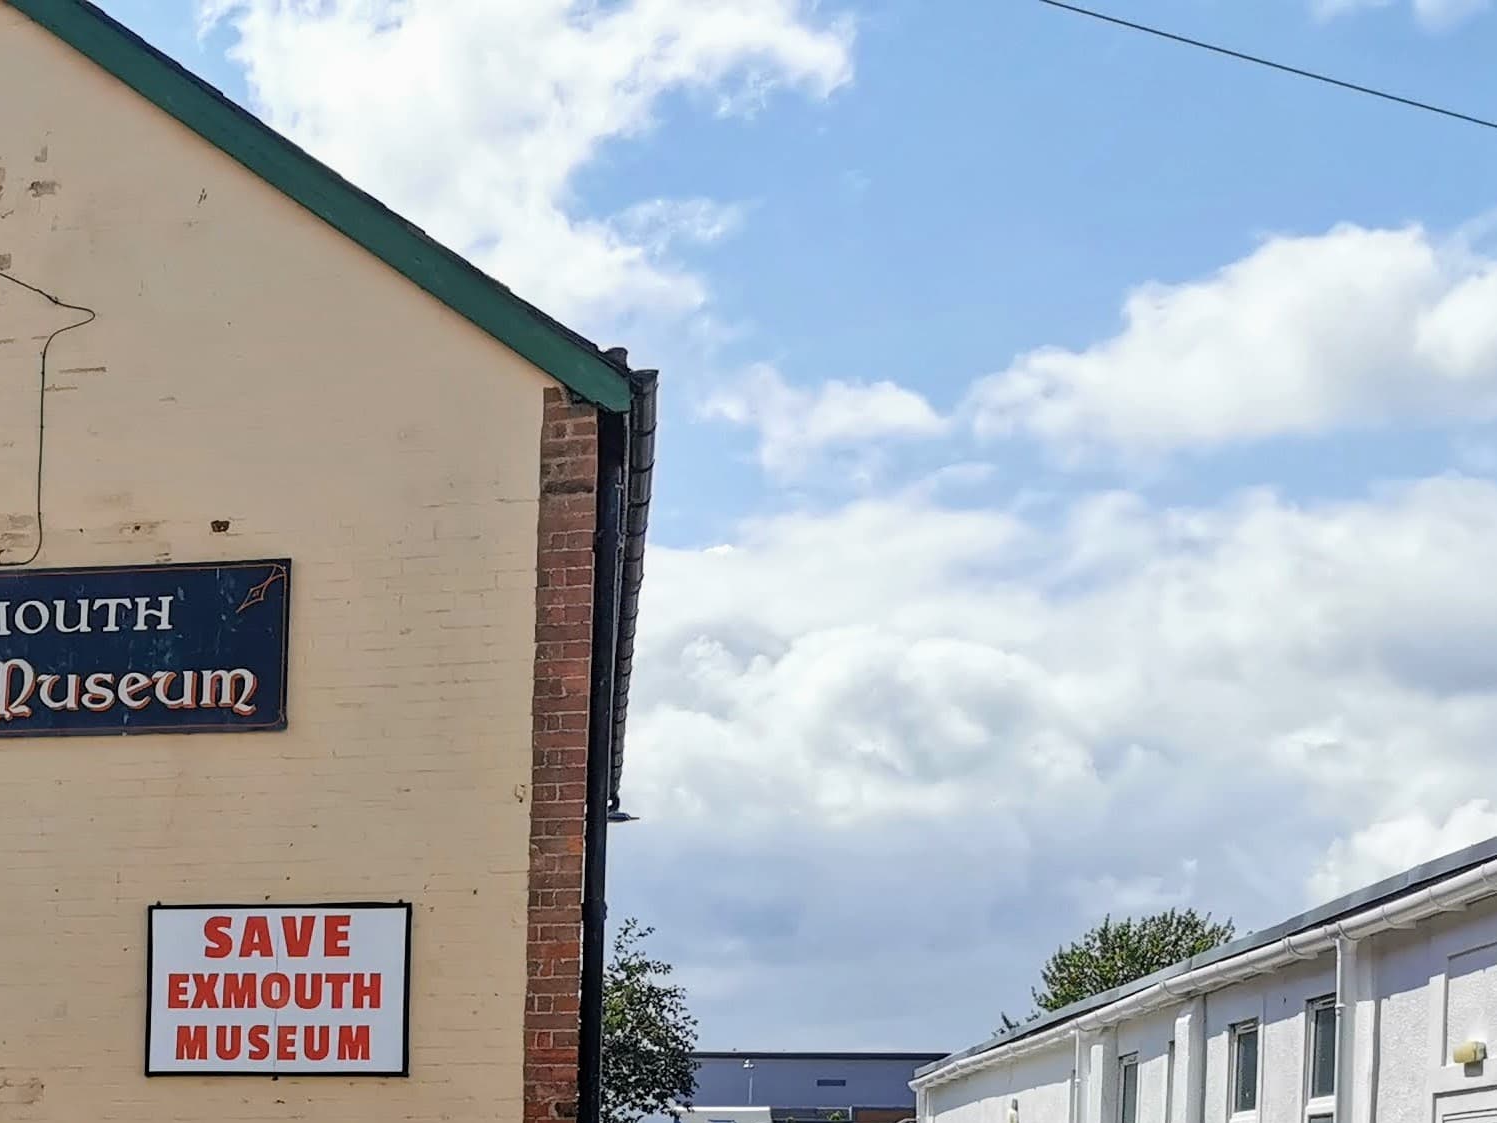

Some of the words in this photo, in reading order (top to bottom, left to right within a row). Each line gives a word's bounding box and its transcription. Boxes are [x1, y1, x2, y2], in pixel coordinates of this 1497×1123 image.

[203, 915, 352, 958] SAVE
[168, 972, 382, 1010] EXMOUTH
[175, 1024, 370, 1061] MUSEUM
